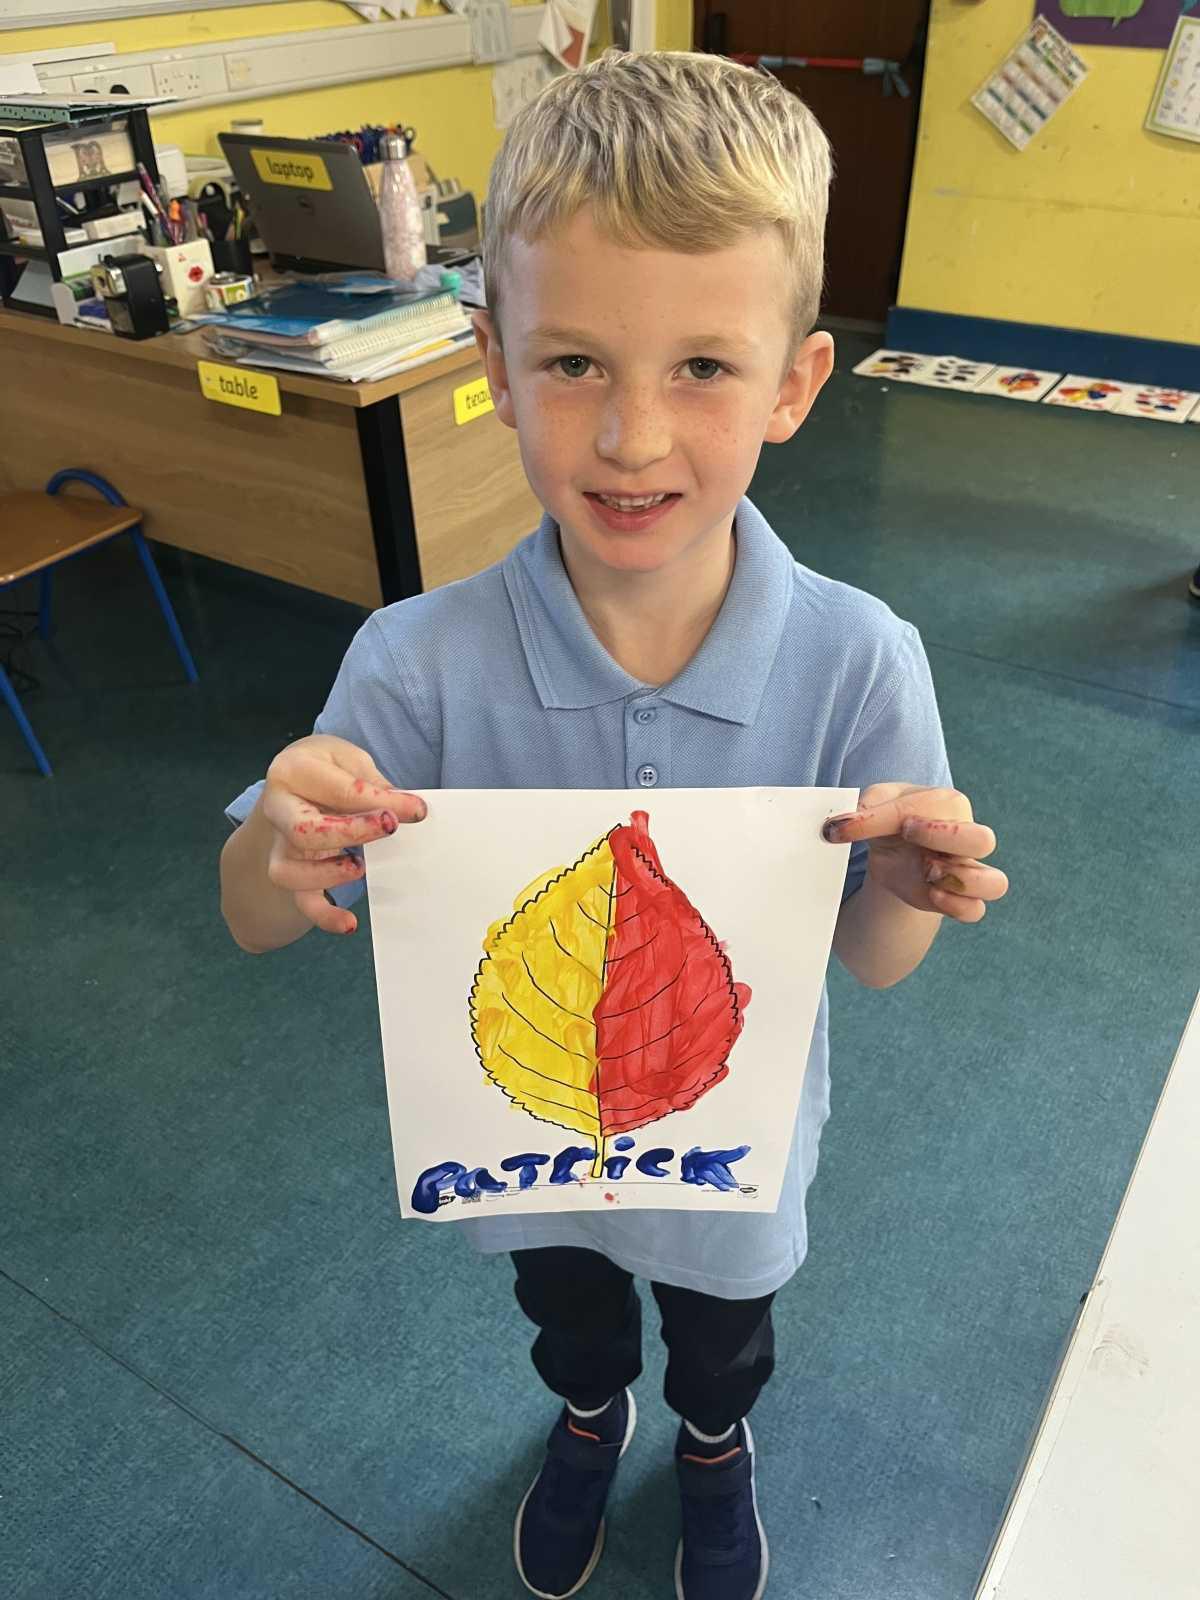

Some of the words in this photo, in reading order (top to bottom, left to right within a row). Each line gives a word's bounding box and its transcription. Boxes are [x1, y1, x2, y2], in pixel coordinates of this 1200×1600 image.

[265, 156, 314, 183] laptop
[219, 375, 259, 400] table
[465, 390, 492, 410] tea
